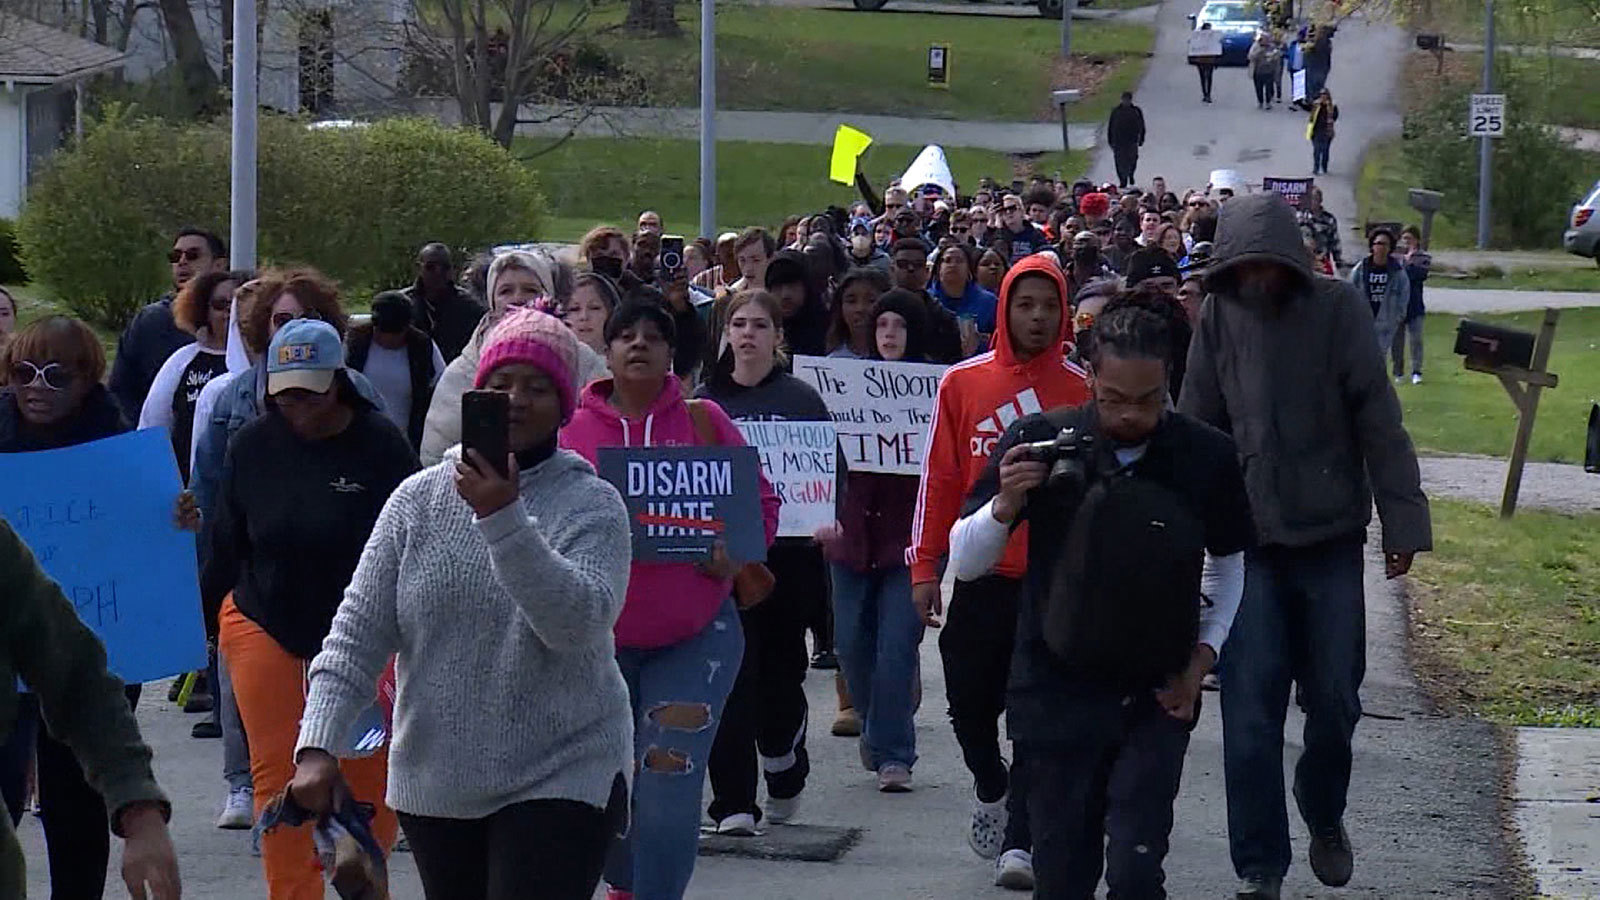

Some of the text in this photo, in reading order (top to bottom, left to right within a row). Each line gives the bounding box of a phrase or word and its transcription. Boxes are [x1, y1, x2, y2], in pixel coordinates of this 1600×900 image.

[1474, 97, 1502, 105] SPEED
[1474, 116, 1501, 131] 25
[1272, 181, 1307, 193] DISARM
[802, 365, 847, 395] The
[870, 409, 892, 423] Do
[783, 451, 835, 474] MORE
[628, 461, 732, 496] DISARM
[648, 502, 715, 537] HATE
